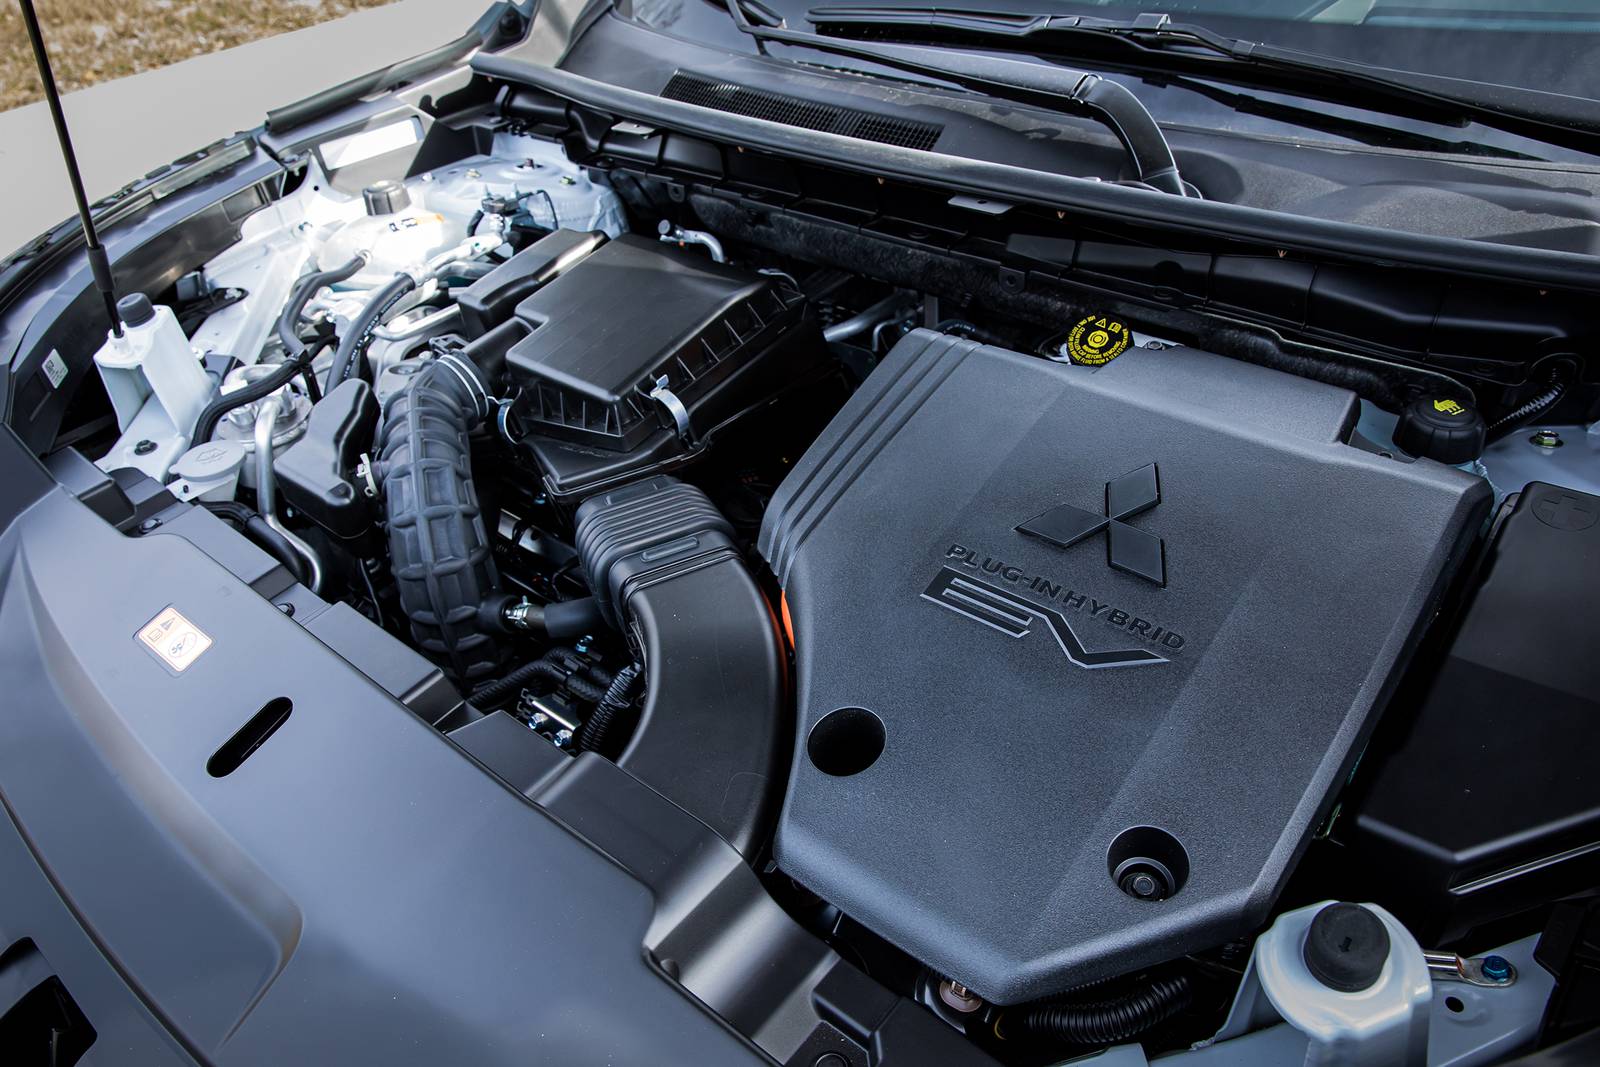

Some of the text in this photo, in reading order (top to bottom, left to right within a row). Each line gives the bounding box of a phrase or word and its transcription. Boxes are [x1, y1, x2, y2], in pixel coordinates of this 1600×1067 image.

[920, 564, 1170, 669] EV
[944, 543, 1186, 651] PLUG-IN HYBRID
